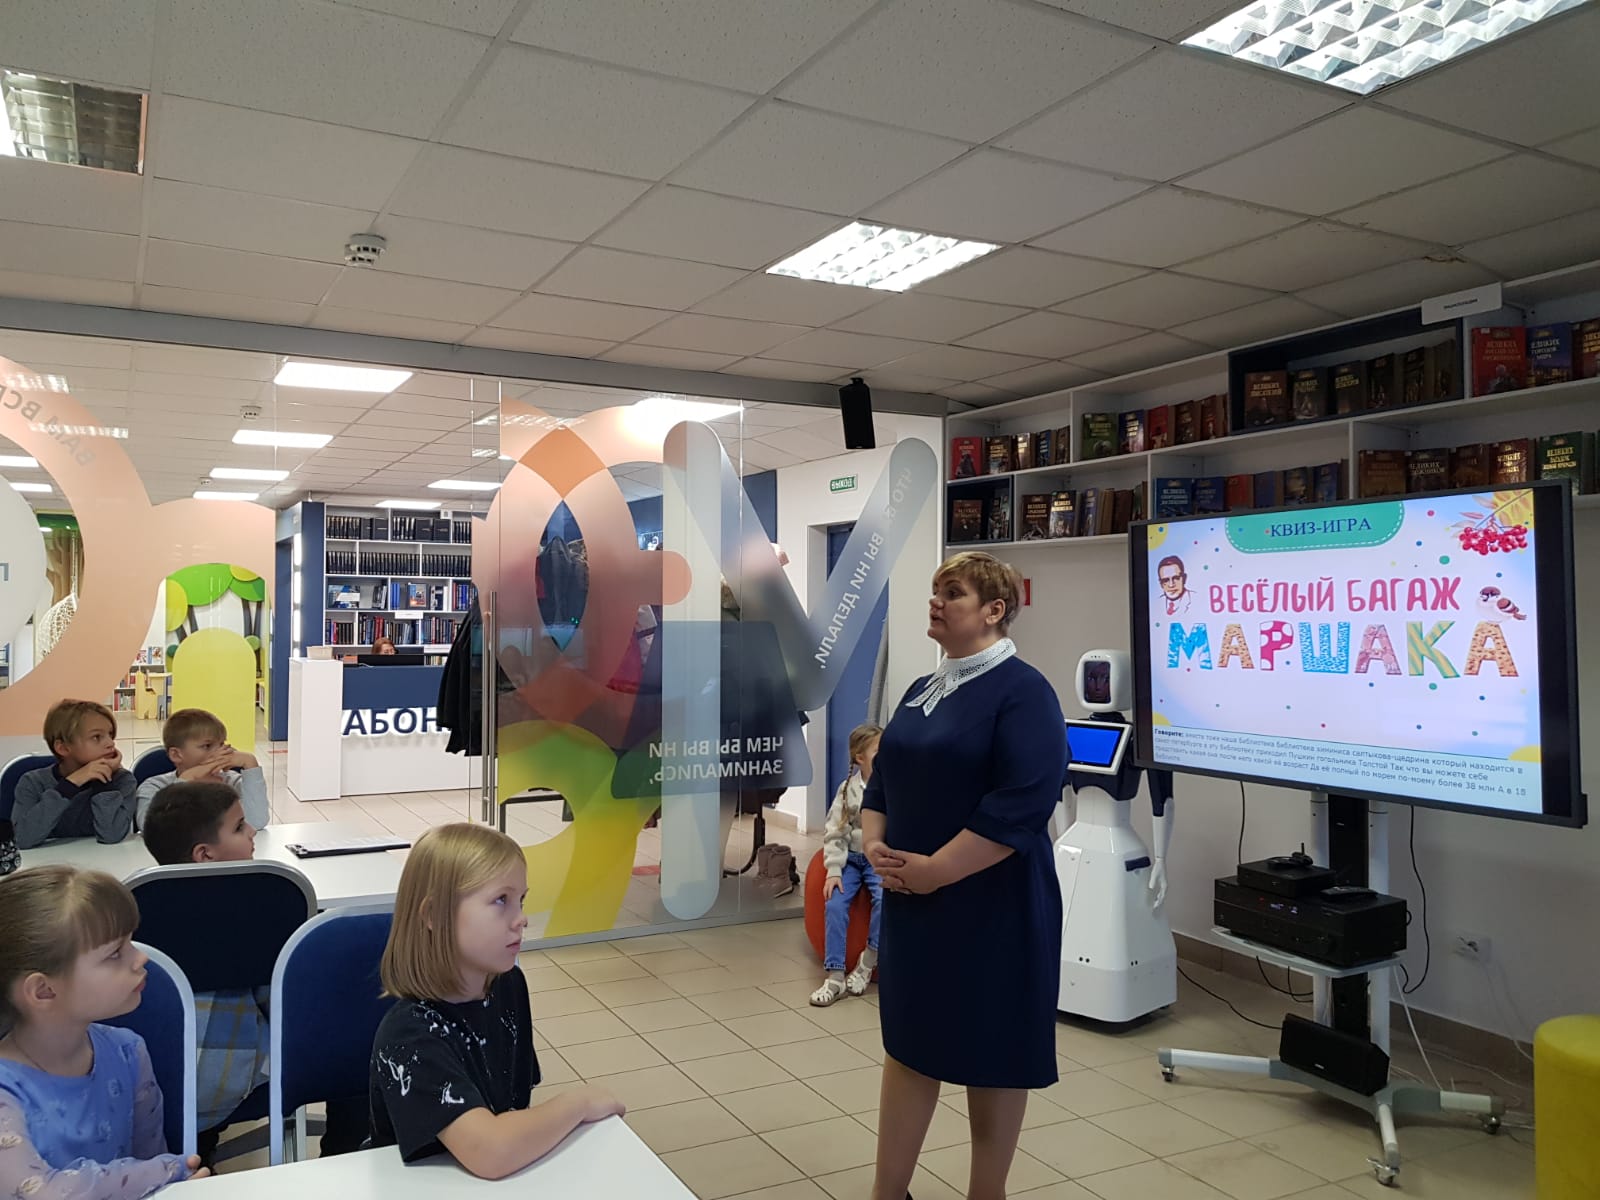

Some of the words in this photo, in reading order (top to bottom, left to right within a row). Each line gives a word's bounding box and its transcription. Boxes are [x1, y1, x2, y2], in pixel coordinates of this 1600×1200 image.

[1270, 517, 1372, 537] КВИЗ-ИГРА
[1209, 577, 1334, 613] ВЕСЁЛЫЙ
[1347, 576, 1461, 612] БАГАЖ
[1166, 620, 1519, 678] МАРШАКА
[1389, 761, 1403, 771] Так
[1405, 765, 1420, 773] что
[1431, 756, 1467, 769] который
[1469, 762, 1515, 774] находится
